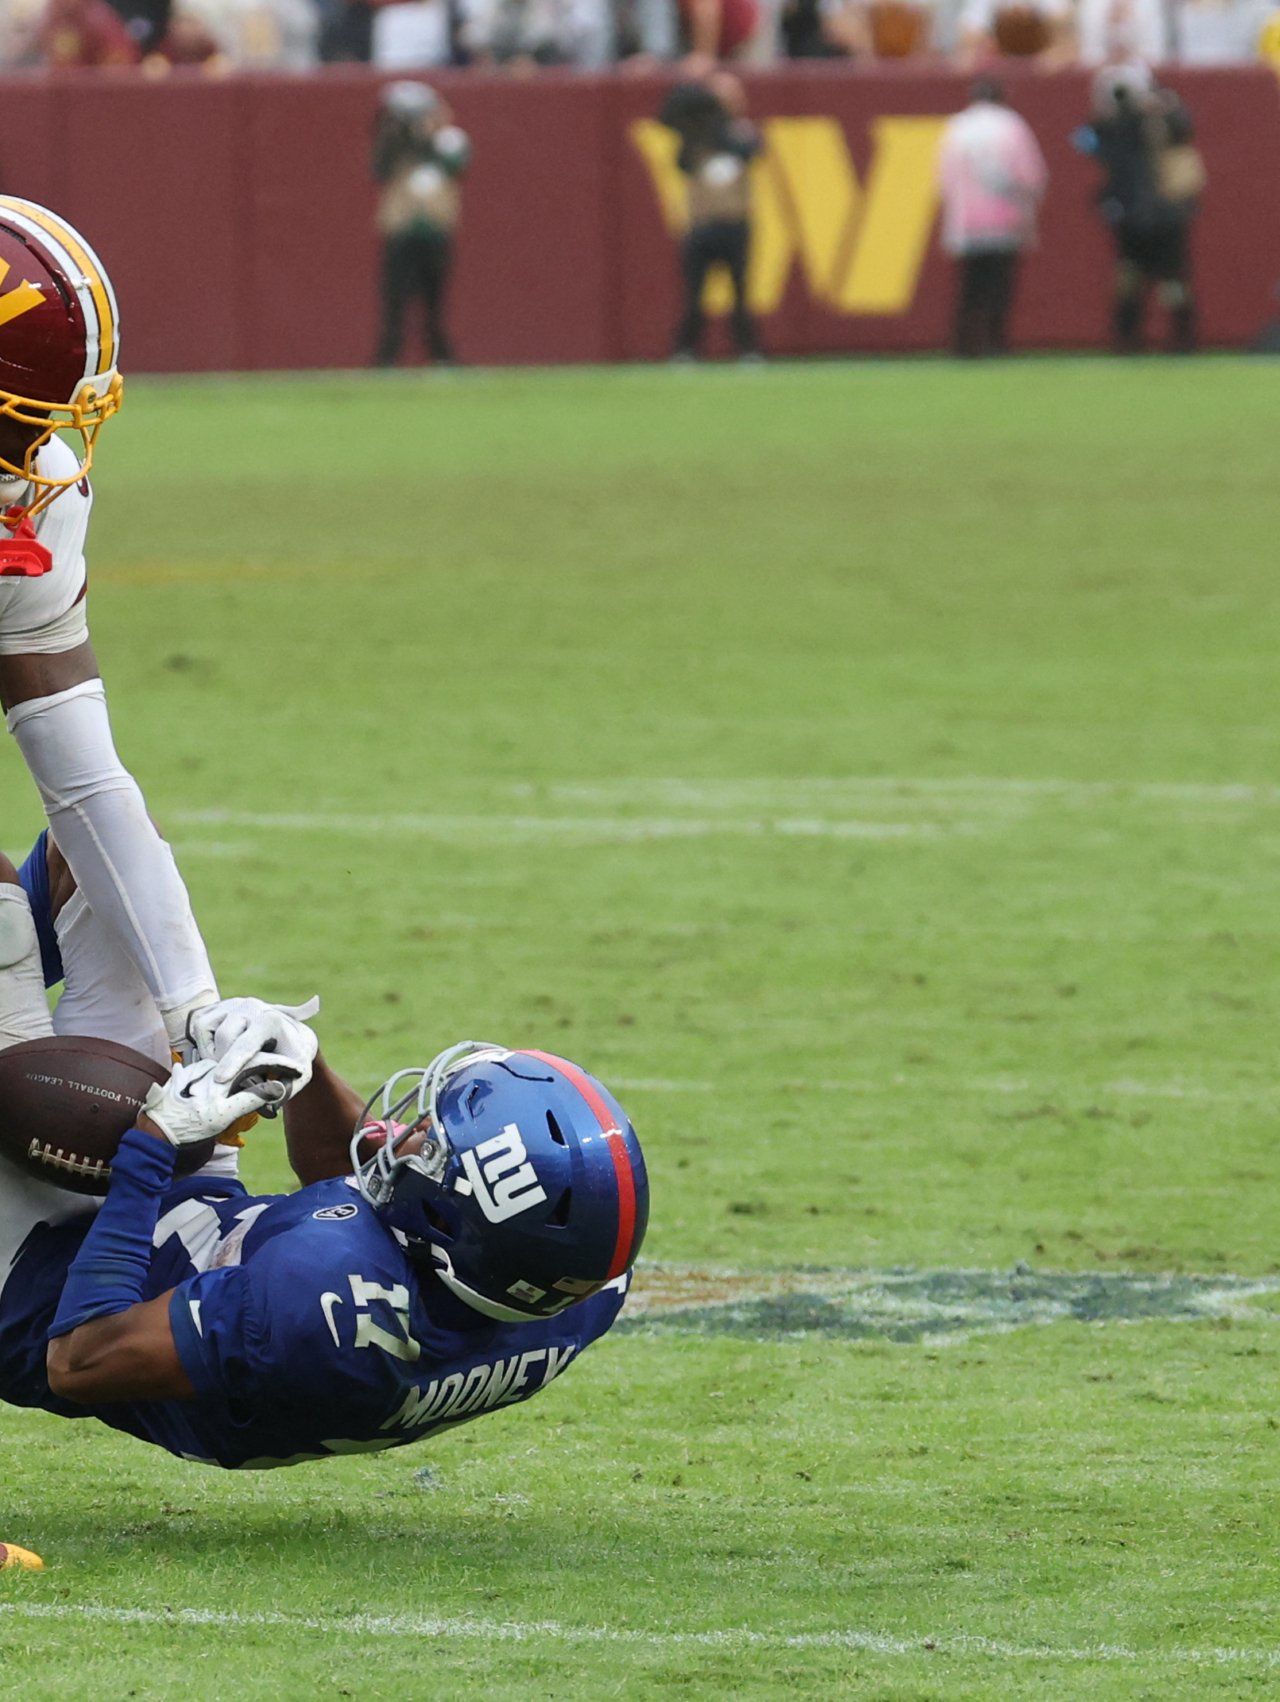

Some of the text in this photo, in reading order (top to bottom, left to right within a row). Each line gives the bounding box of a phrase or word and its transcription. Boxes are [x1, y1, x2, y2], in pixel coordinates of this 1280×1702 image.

[68, 1080, 122, 1102] FOOTBALL
[347, 1274, 421, 1362] 17
[378, 1345, 577, 1430] MOONEY
